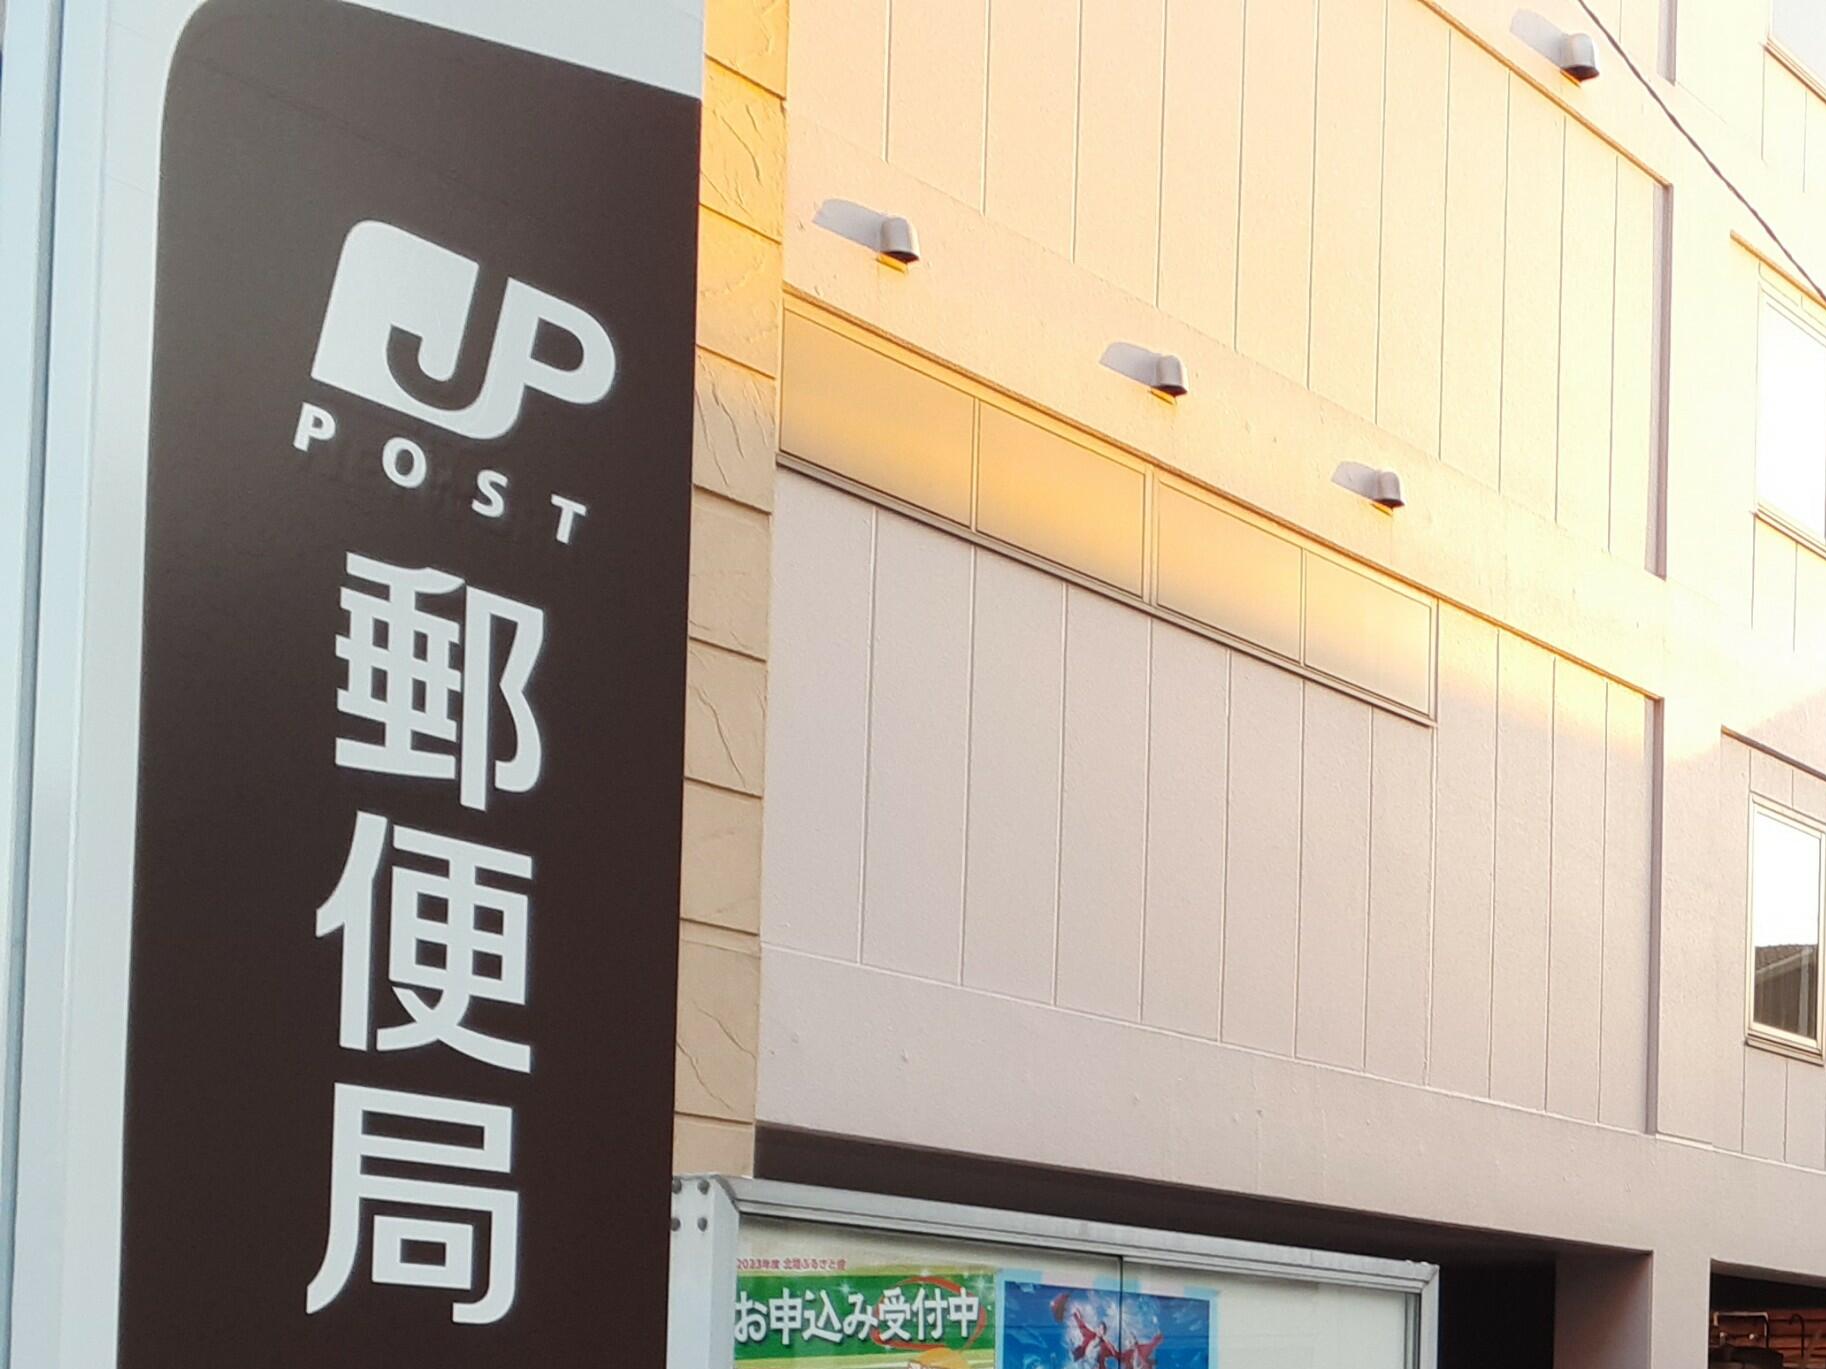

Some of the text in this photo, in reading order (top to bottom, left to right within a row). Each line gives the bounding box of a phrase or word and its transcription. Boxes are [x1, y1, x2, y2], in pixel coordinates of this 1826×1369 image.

[293, 401, 588, 545] POST
[306, 551, 544, 1325] 郵便局
[734, 1286, 980, 1346] お申込み受付中
